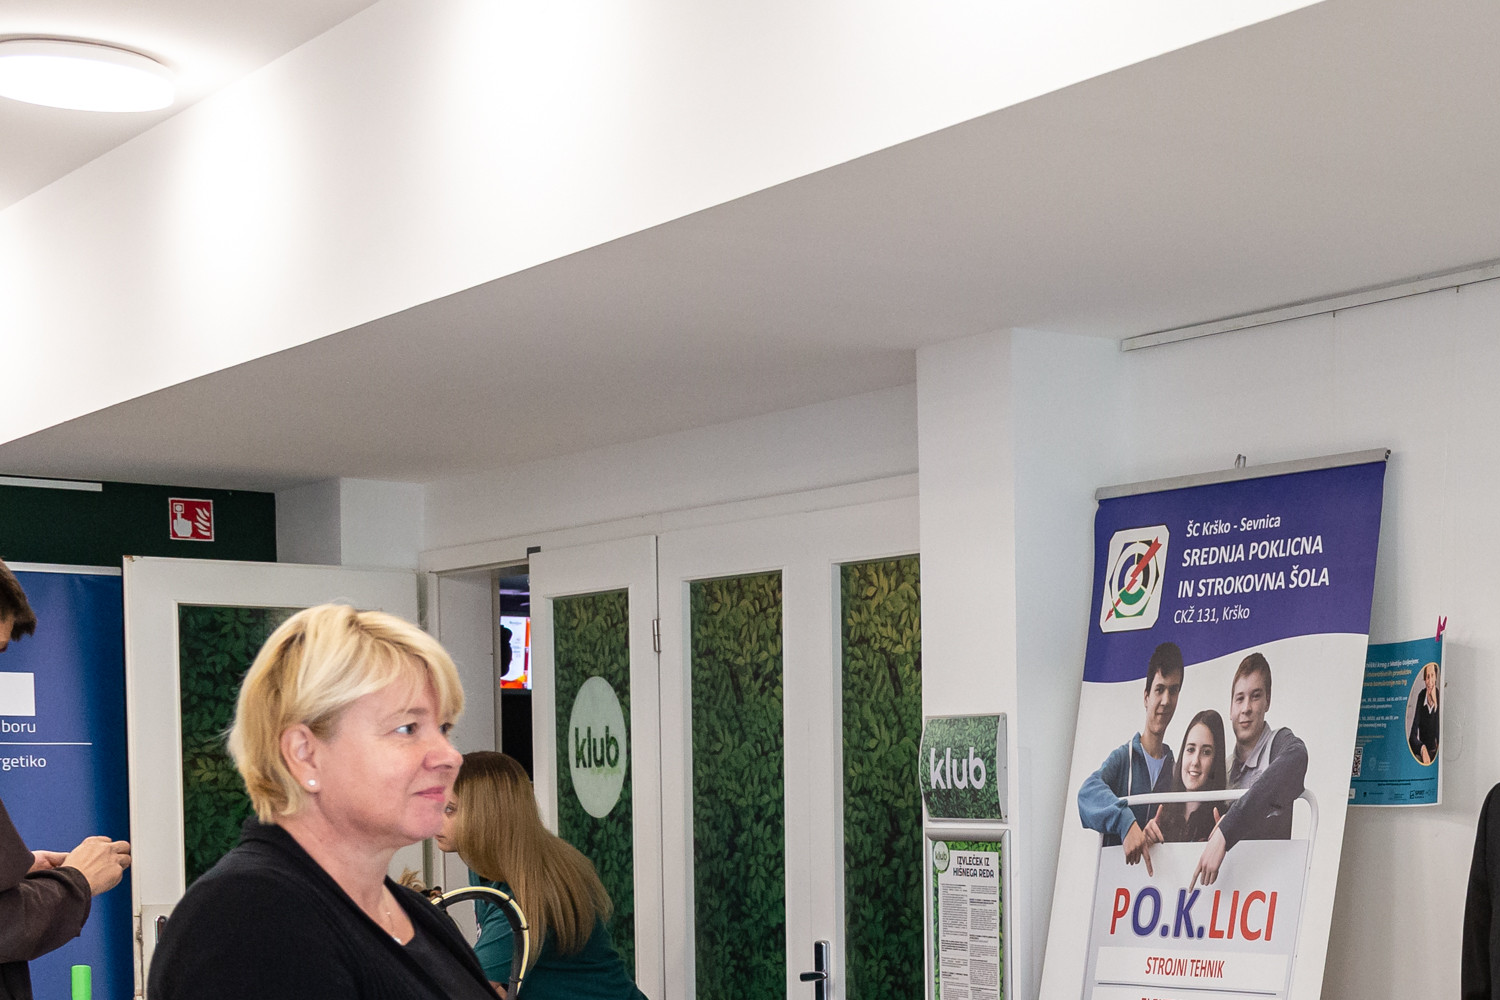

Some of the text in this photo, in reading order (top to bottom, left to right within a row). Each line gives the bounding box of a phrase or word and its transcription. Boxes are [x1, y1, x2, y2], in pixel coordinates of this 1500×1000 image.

[1186, 520, 1200, 537] ŠC
[1202, 520, 1230, 536] Krško
[1240, 514, 1281, 532] Sevnica
[1182, 535, 1323, 567] SREDNJA POKLICNA
[1177, 564, 1330, 599] IN STROKOVNA ŠOLA
[1174, 604, 1250, 624] CKŽ 131, Krško
[575, 726, 619, 768] klub
[930, 746, 986, 790] klub
[953, 866, 994, 878] HIŠNEGA REDA
[956, 854, 990, 866] IZVLEČEK IZ
[1109, 886, 1278, 942] PO.K.LICI
[1145, 956, 1225, 978] STROJNI TEHNIK
